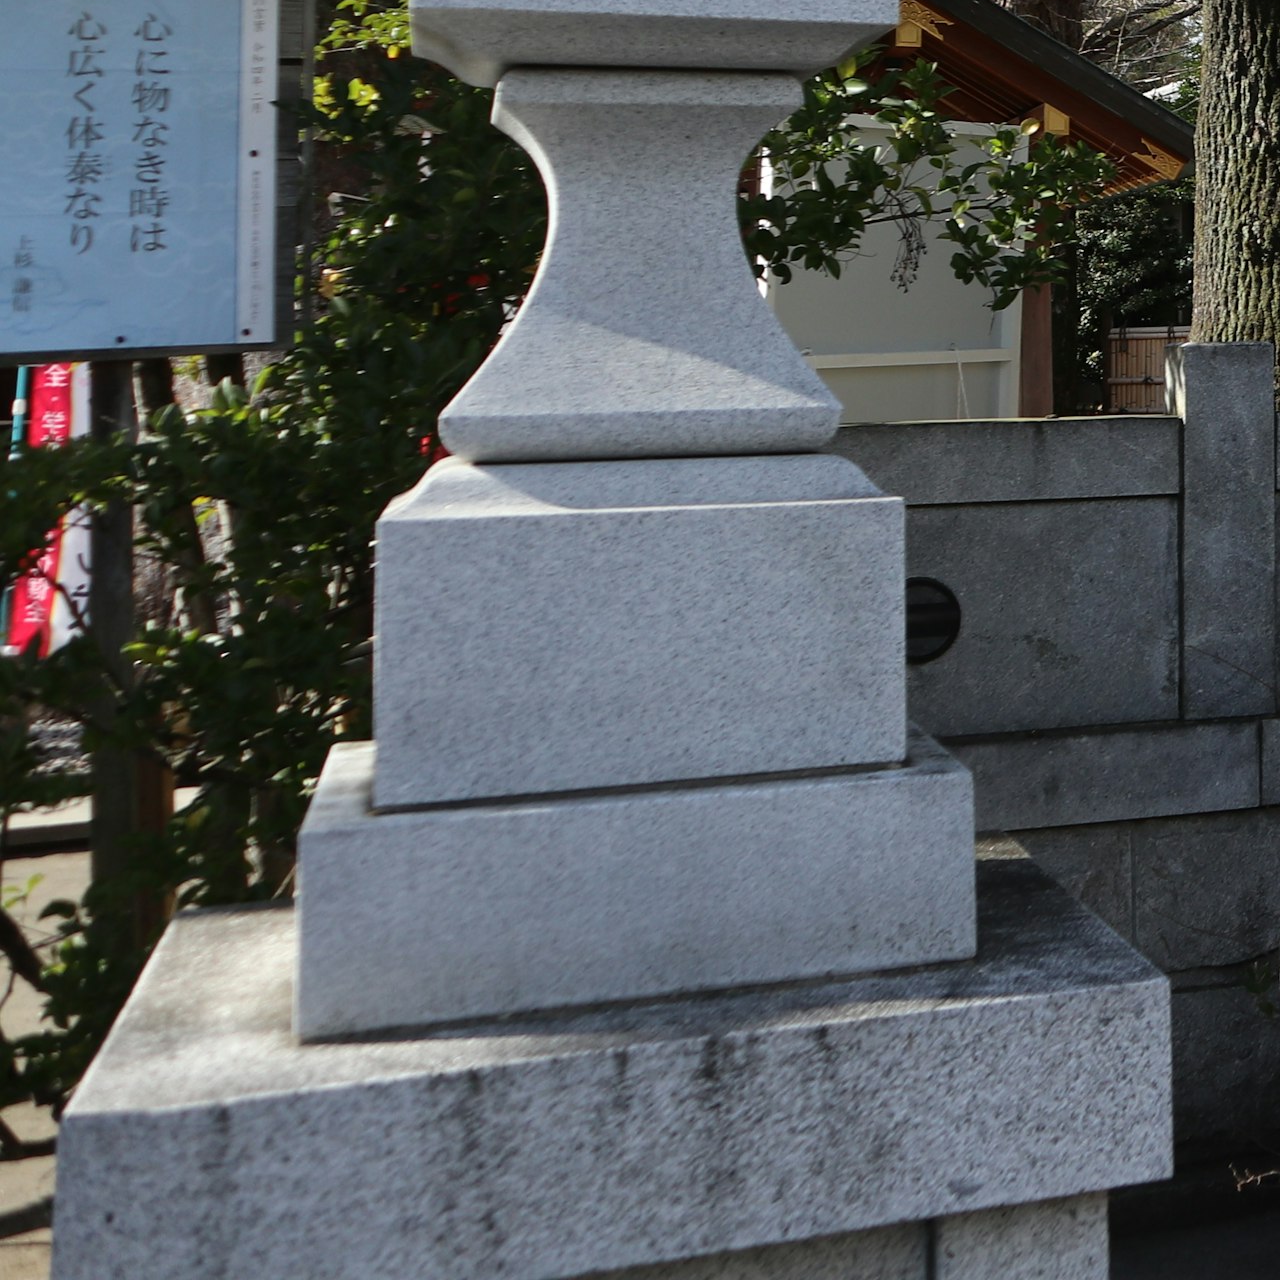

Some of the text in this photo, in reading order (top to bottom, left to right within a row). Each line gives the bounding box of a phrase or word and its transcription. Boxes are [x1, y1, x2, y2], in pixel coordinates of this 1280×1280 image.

[64, 10, 107, 256] 心広く体泰なり
[129, 11, 174, 253] 心に物なき時は
